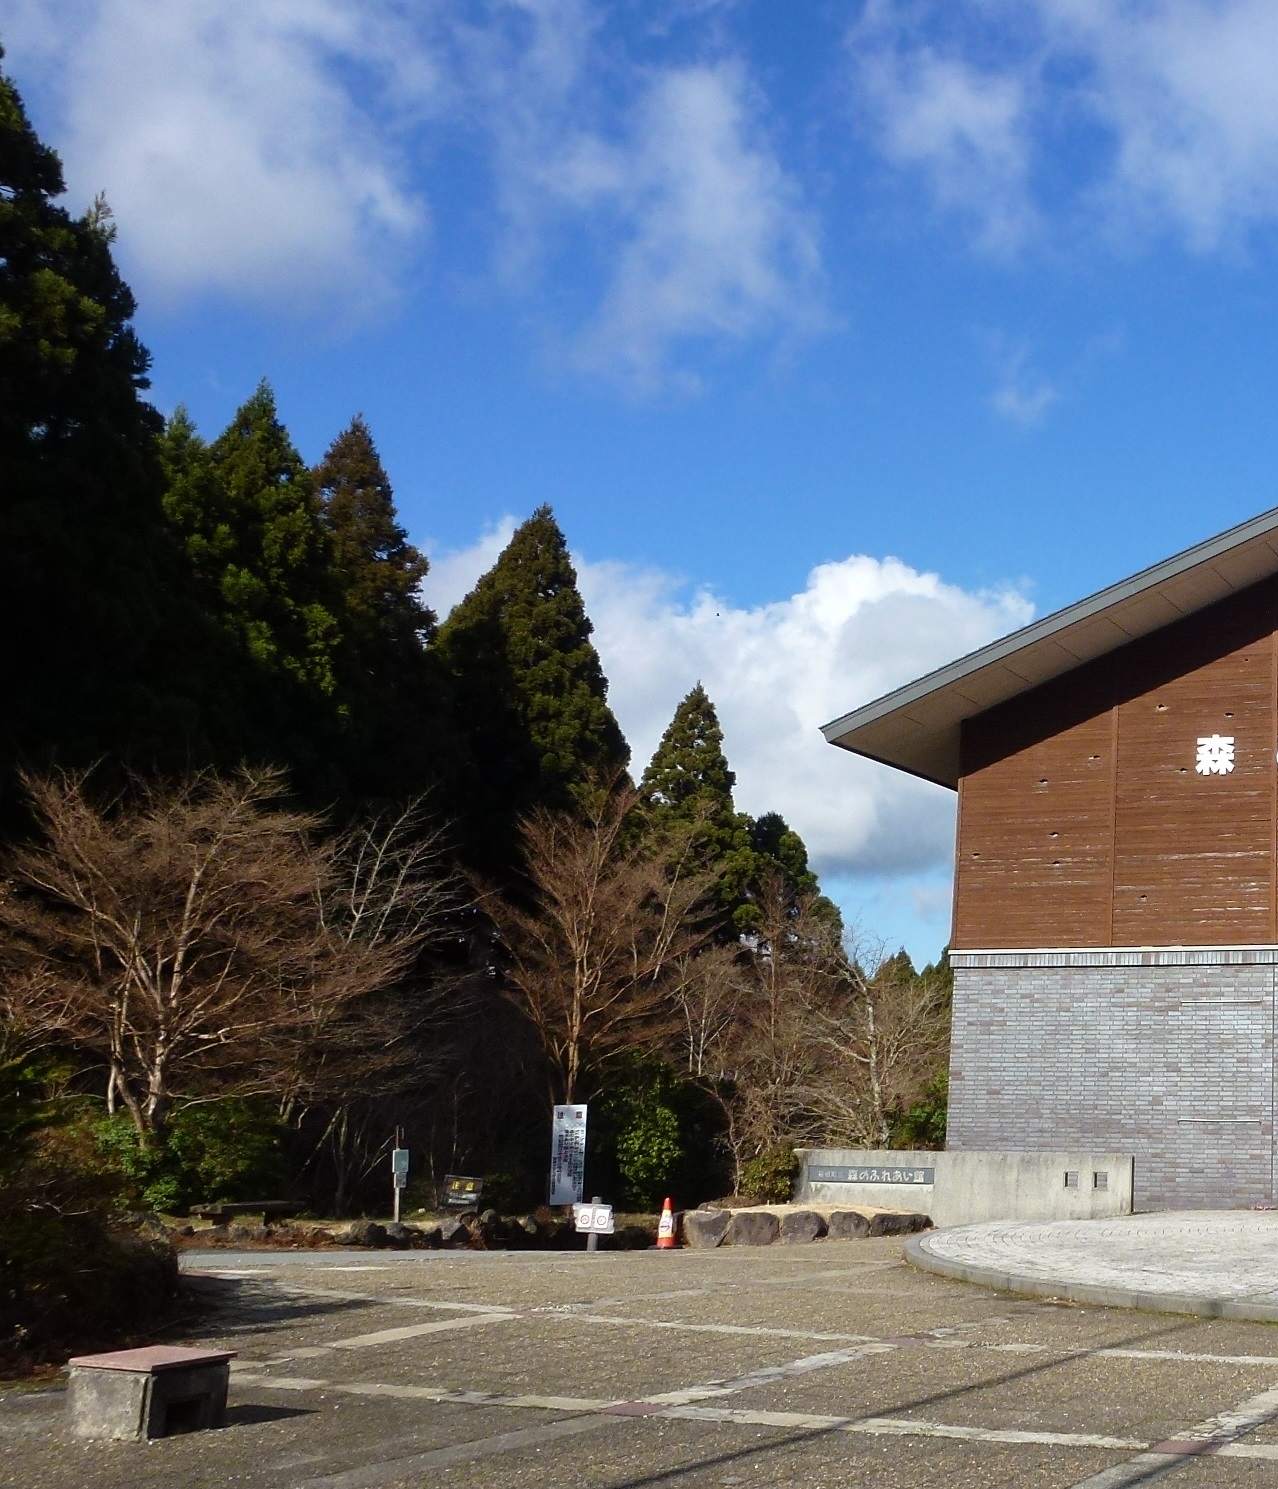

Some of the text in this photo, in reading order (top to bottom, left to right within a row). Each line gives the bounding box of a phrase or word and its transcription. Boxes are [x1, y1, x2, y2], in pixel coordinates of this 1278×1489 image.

[847, 1169, 925, 1183] 森のふれあい館
